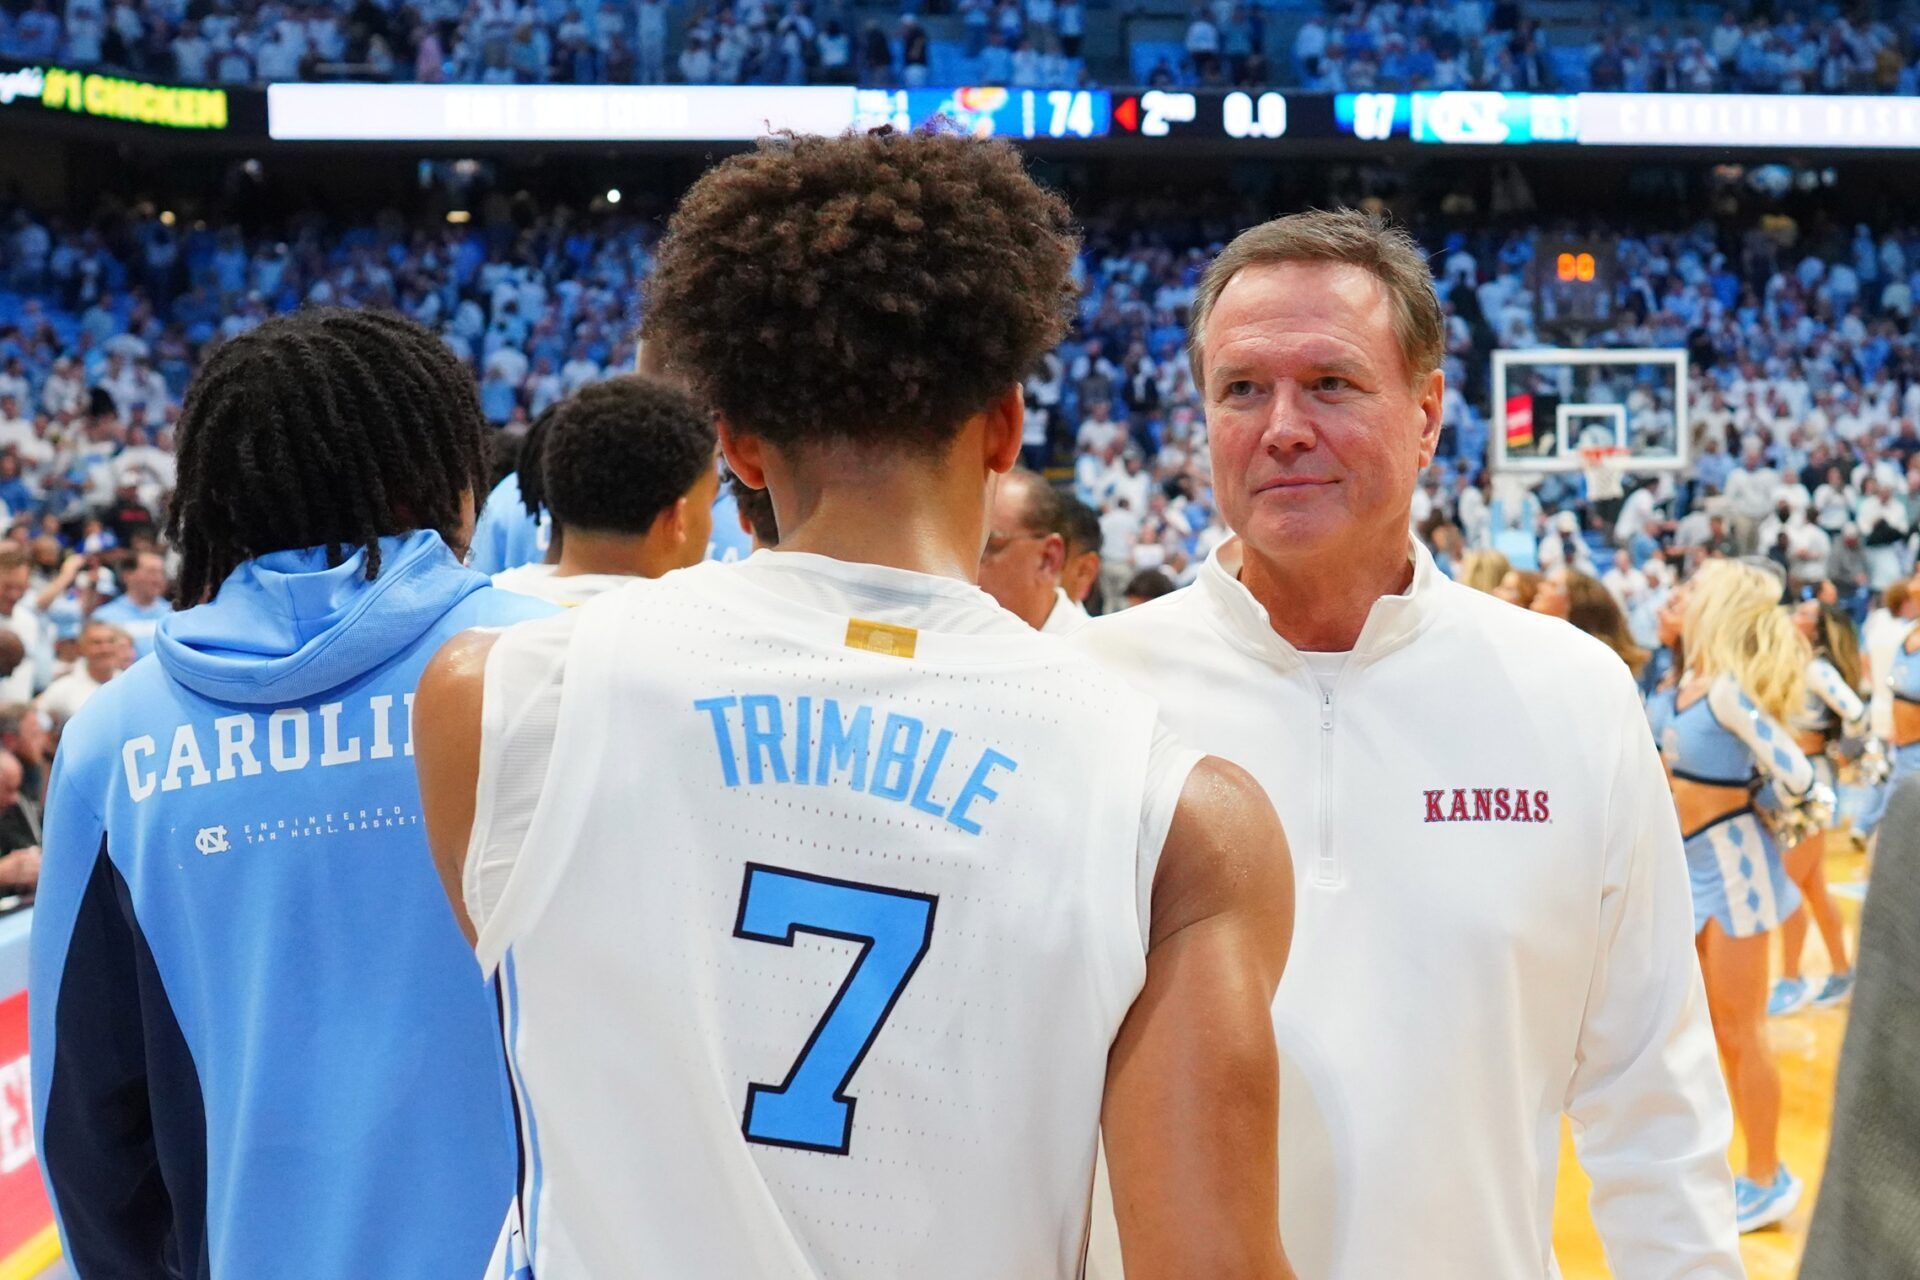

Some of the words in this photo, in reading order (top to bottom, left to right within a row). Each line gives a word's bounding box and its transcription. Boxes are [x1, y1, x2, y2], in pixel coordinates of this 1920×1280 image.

[42, 67, 83, 111] #1
[1048, 90, 1094, 138] 74
[694, 693, 1018, 836] TRIMBLE
[244, 805, 402, 834] ENGINEERED
[1423, 787, 1551, 823] KANSAS
[246, 832, 277, 845] TAR
[348, 815, 426, 831] BASKET
[733, 861, 938, 1156] 7
